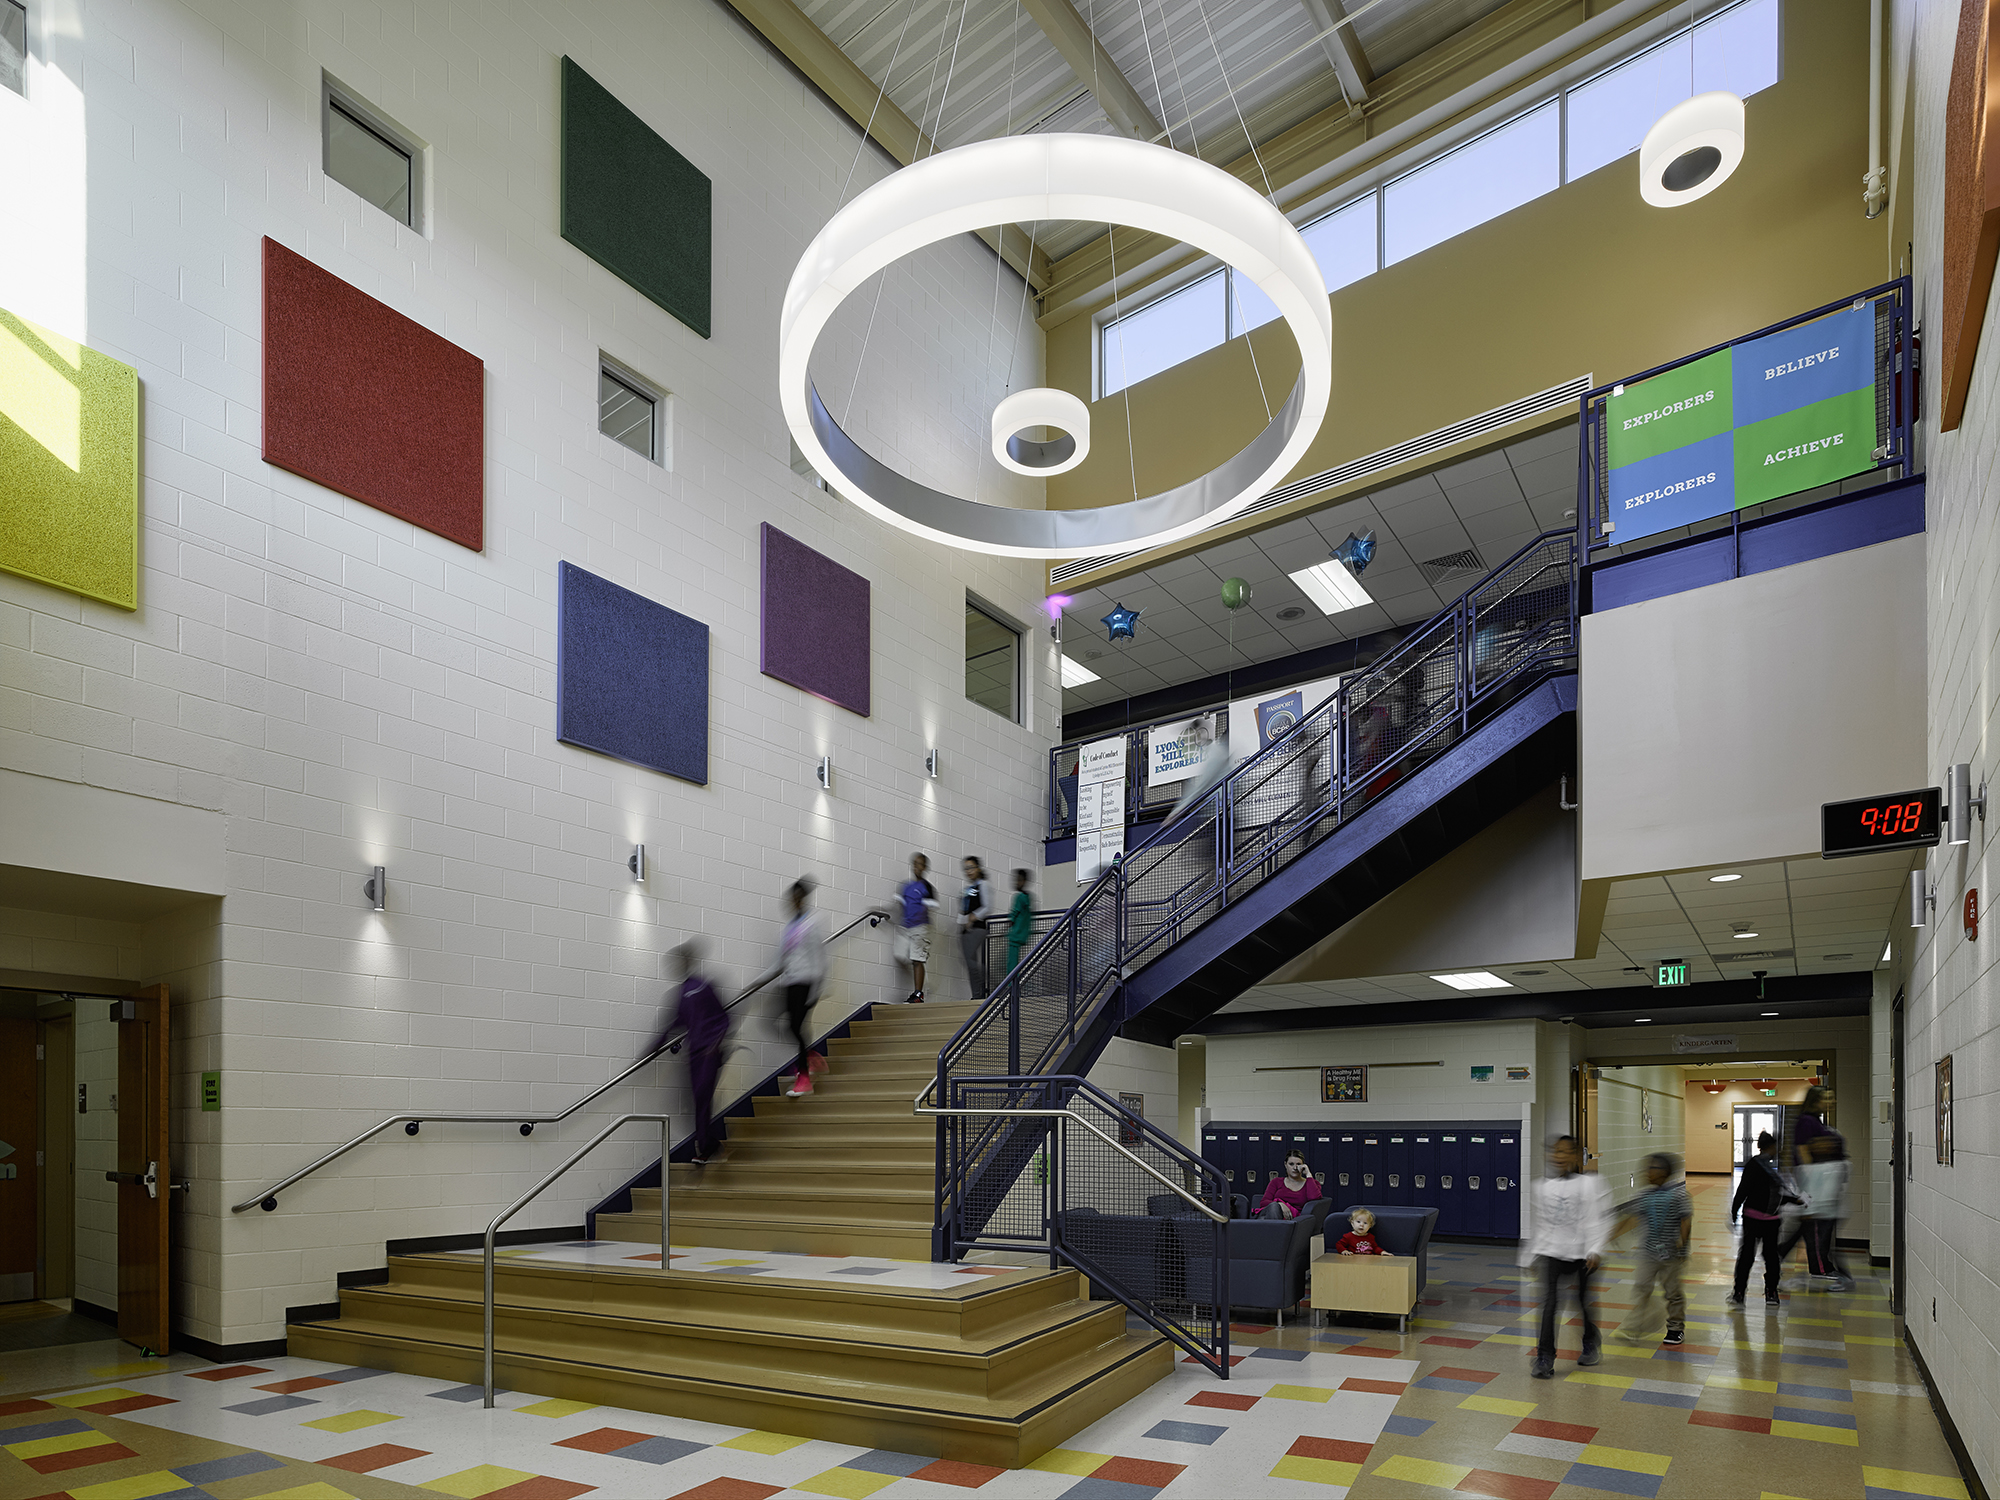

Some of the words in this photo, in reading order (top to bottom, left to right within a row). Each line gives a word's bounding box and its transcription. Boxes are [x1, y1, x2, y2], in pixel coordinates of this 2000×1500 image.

[1764, 346, 1840, 381] BELIEVE
[1623, 390, 1715, 431] EXPLORERS
[1763, 433, 1844, 466] ACHIEVE
[1624, 472, 1716, 510] EXPLORERS
[1266, 700, 1295, 712] PASSPORT
[1155, 739, 1185, 754] LYONS
[1161, 750, 1185, 762] MILL
[1155, 756, 1199, 773] EXPLORERS
[1860, 801, 1923, 836] 9:08
[1658, 965, 1686, 986] EXIT
[1679, 1039, 1733, 1047] KINDERGARTEN
